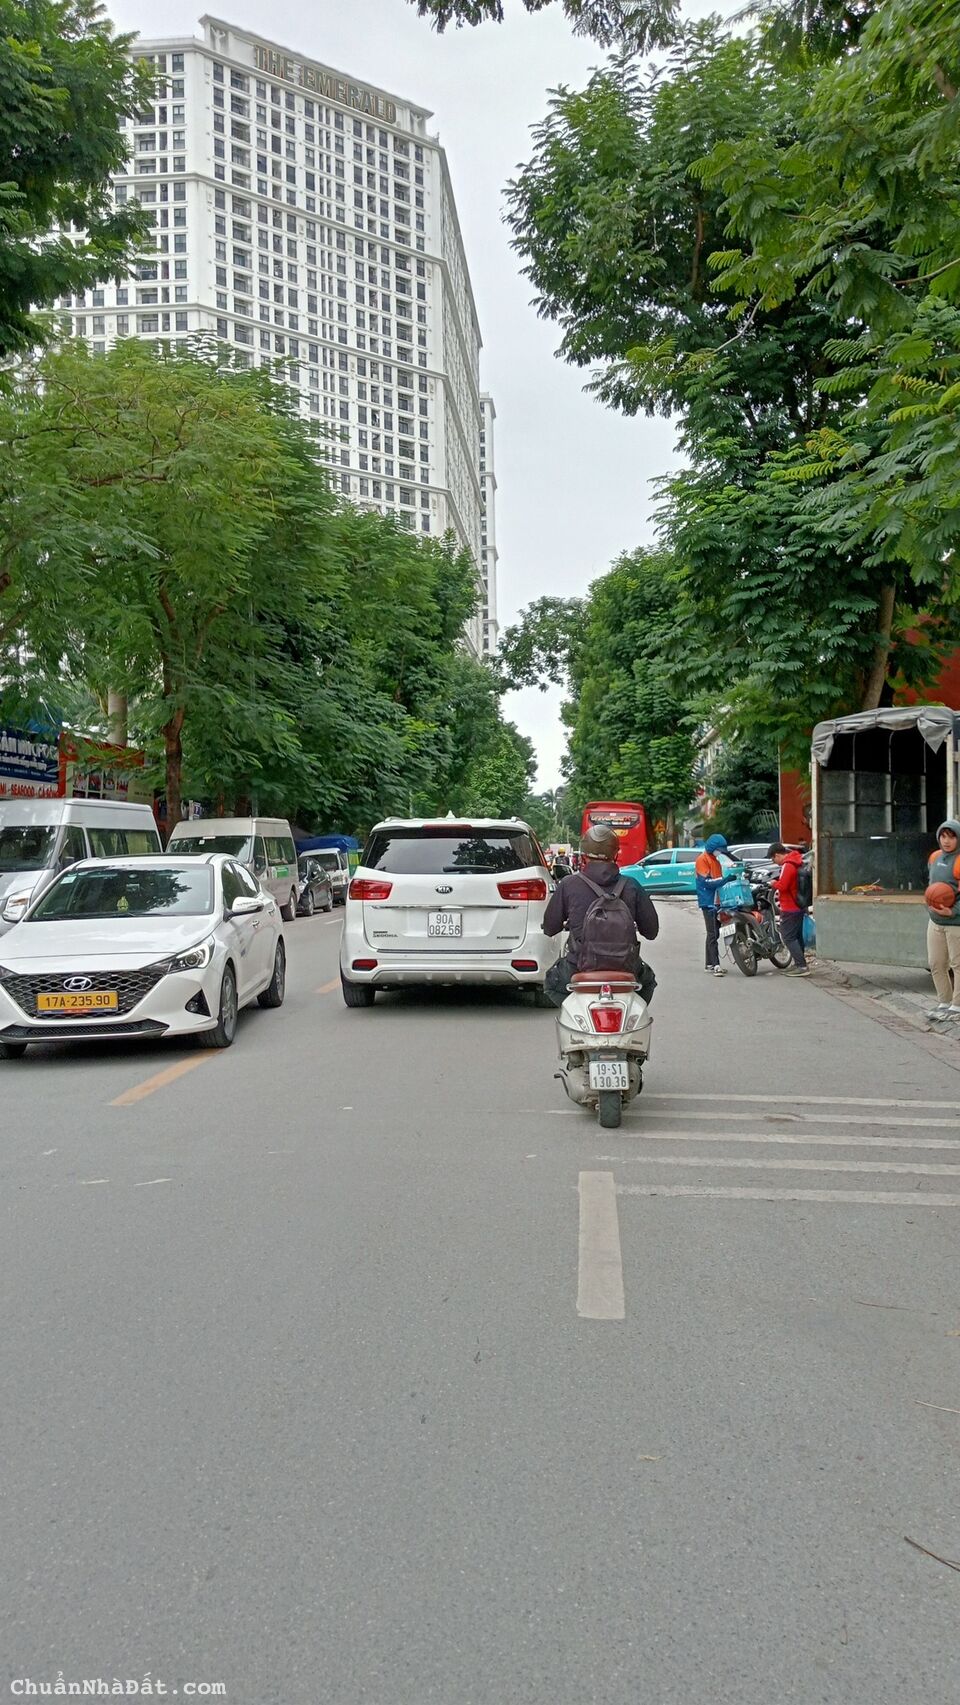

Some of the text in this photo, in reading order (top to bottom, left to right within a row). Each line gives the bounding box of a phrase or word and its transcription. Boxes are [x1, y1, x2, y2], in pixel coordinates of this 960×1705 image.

[255, 44, 396, 124] THE EMERALD
[436, 913, 454, 925] 90A
[429, 925, 461, 936] 082.56
[46, 995, 110, 1007] 17A-235.90
[596, 1064, 623, 1076] 19-S1
[593, 1076, 627, 1088] 130.36
